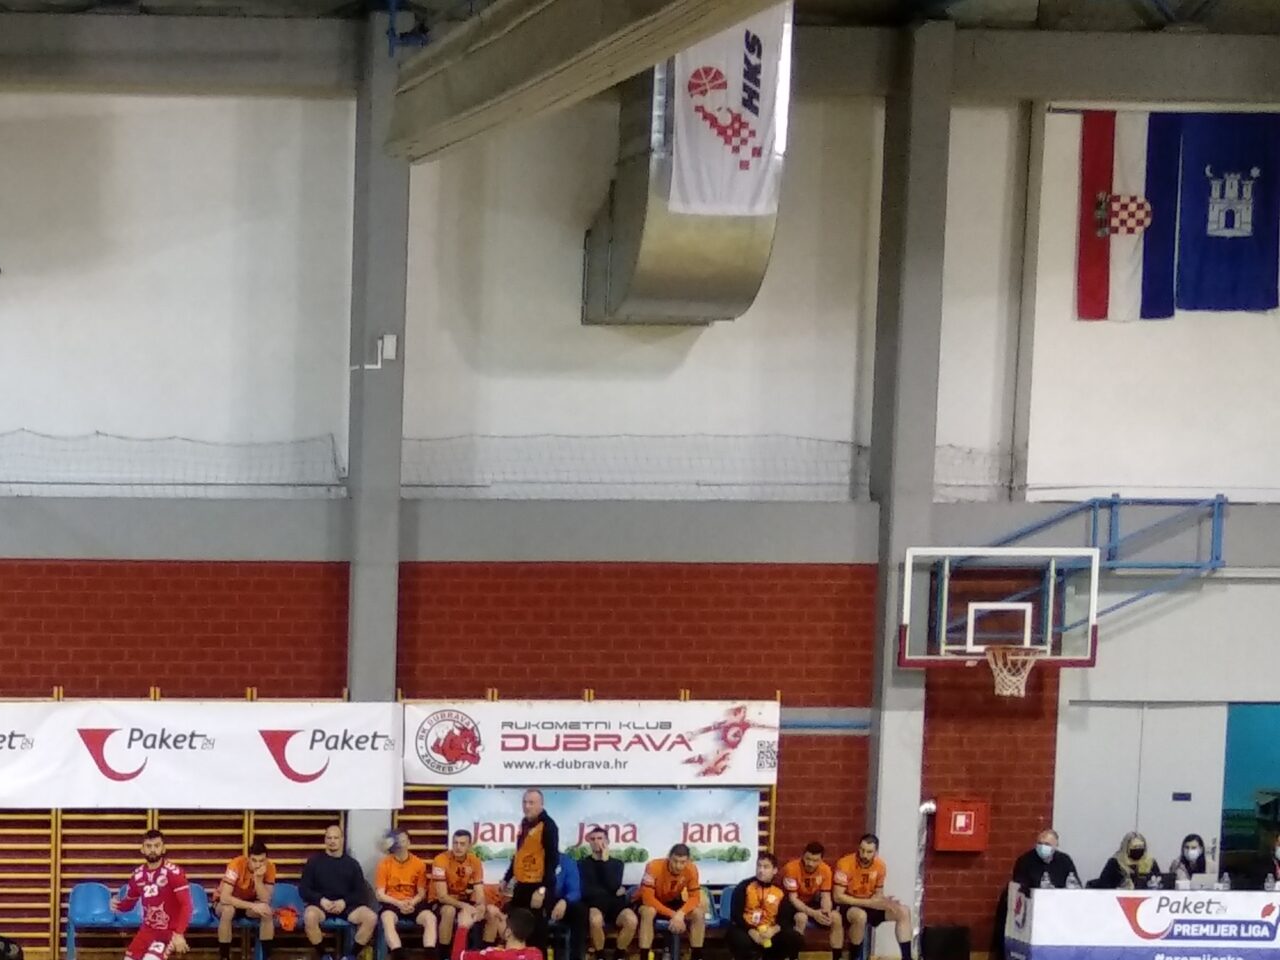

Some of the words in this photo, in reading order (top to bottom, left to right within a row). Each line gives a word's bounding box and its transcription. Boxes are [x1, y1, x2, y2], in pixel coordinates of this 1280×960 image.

[742, 29, 762, 117] HKS
[619, 721, 672, 730] KLUB
[500, 733, 693, 752] DUBRAVA
[503, 758, 629, 771] www.rk-dubrava.hr
[143, 884, 159, 898] 23
[1173, 923, 1237, 937] PREMIJER
[1240, 923, 1269, 937] LIGA
